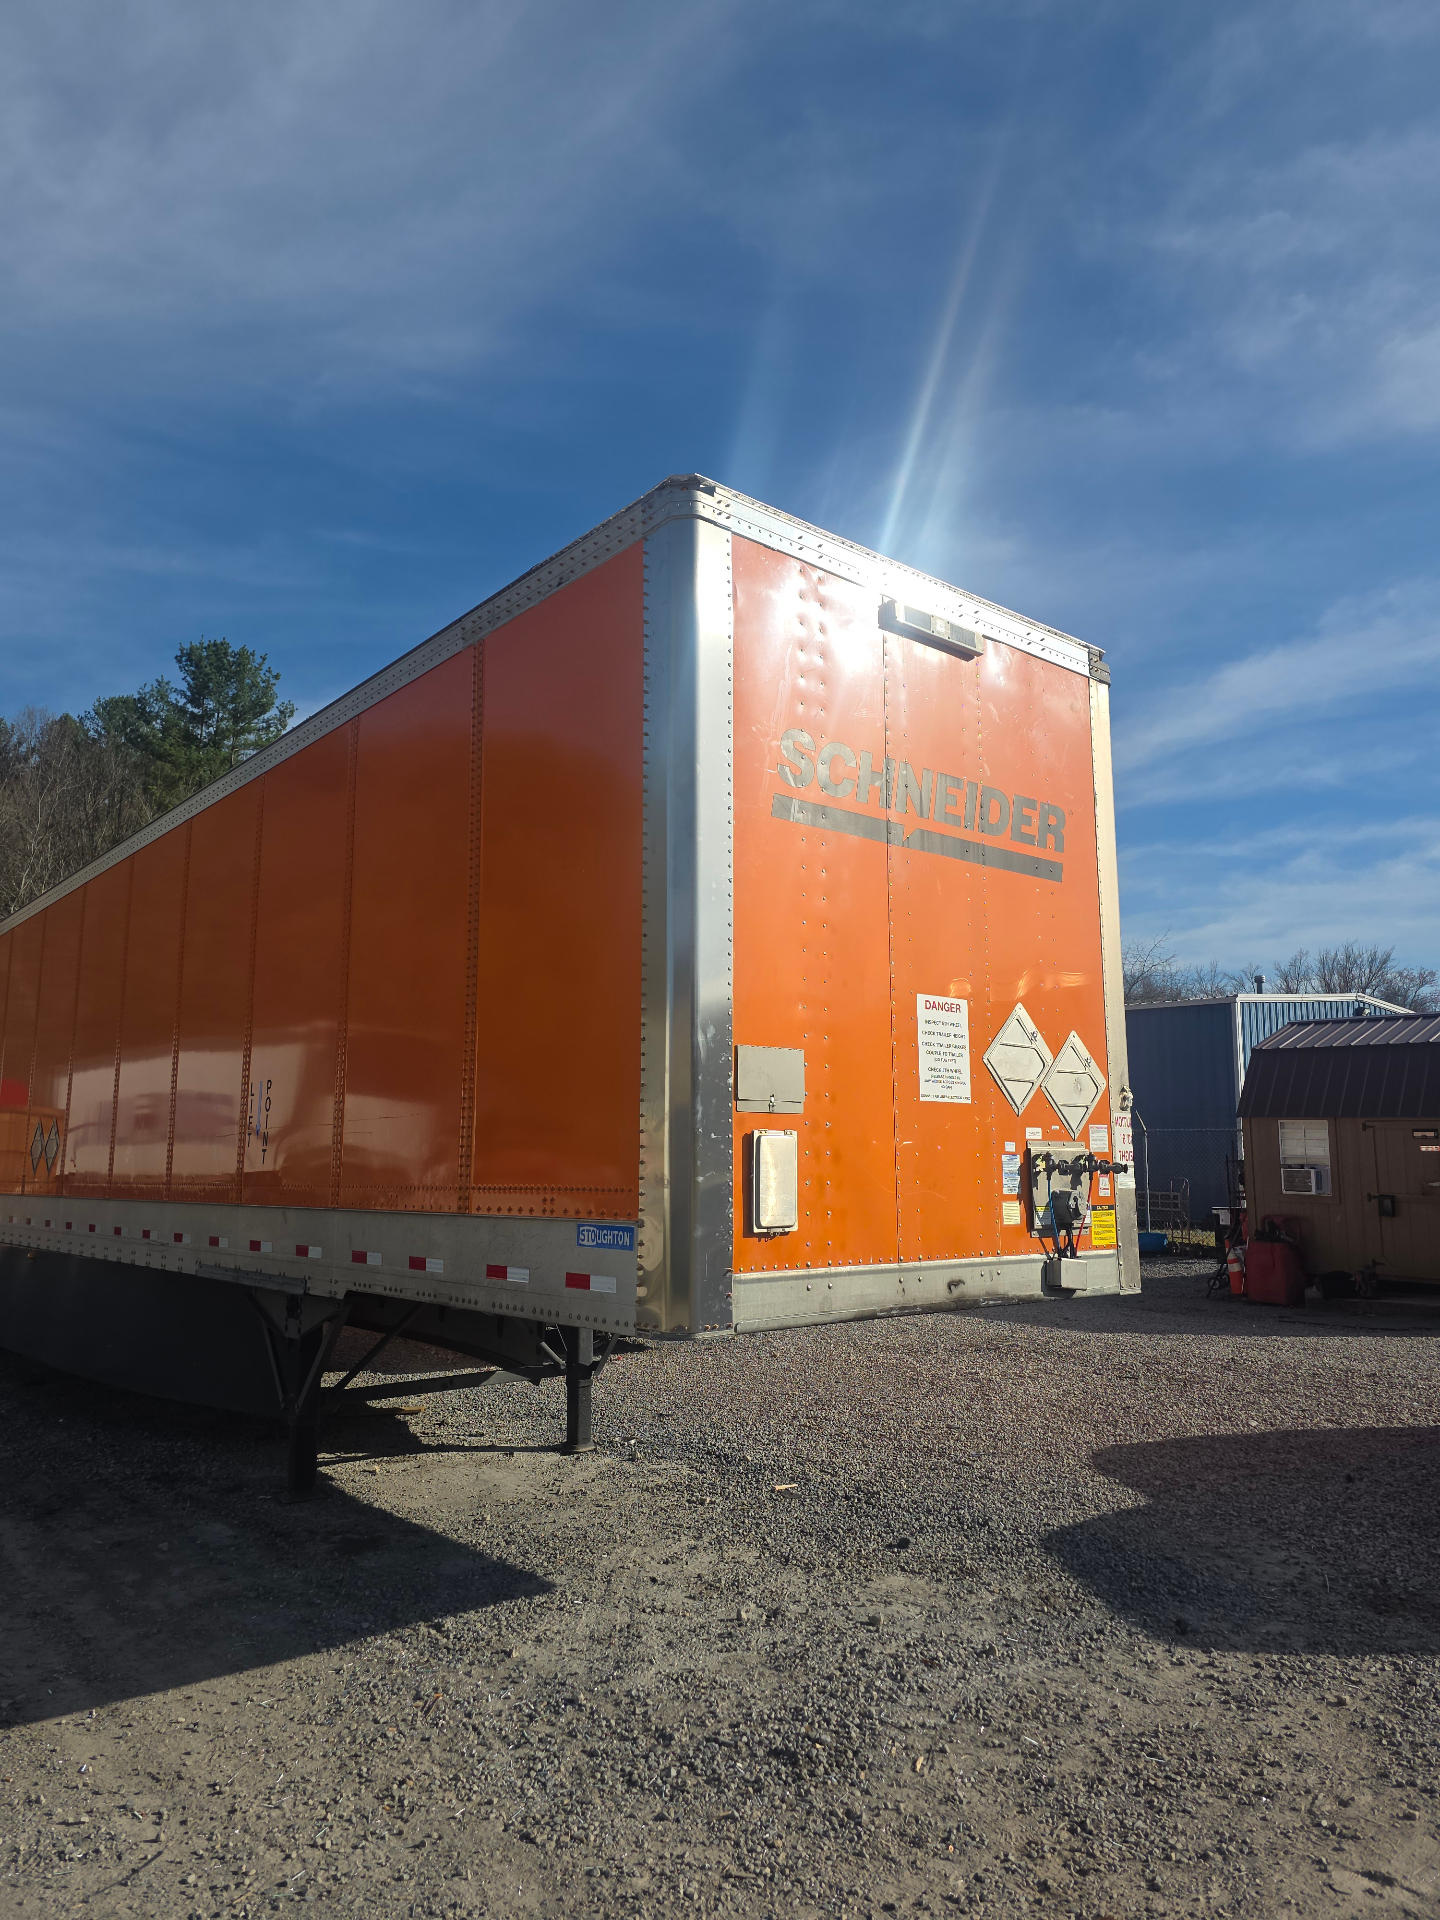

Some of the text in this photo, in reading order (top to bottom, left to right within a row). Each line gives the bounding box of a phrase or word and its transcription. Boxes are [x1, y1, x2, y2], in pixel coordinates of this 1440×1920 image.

[777, 728, 1066, 853] SCHNEIDER
[925, 1000, 961, 1013] DANGER
[262, 1080, 272, 1164] POINT
[579, 1227, 630, 1246] STOUGHTON
